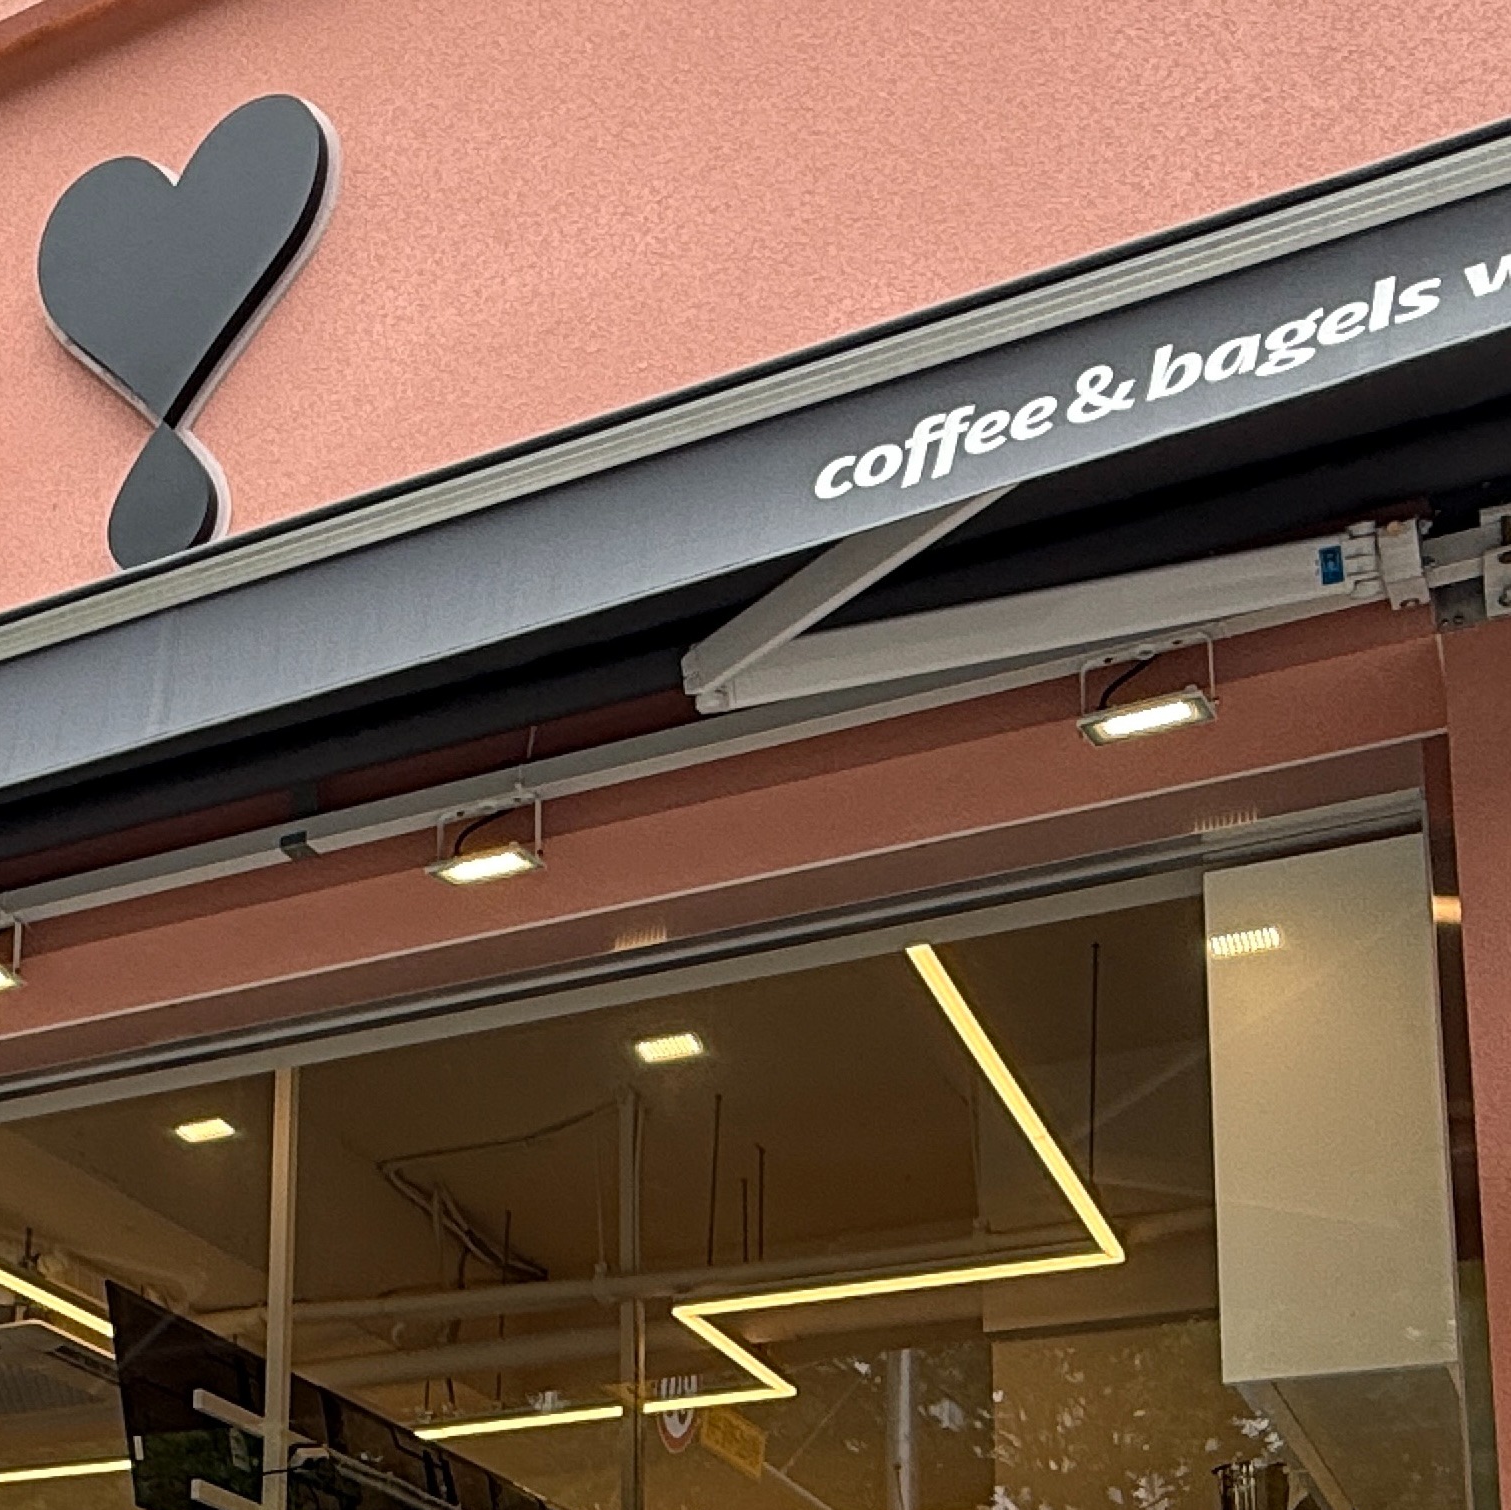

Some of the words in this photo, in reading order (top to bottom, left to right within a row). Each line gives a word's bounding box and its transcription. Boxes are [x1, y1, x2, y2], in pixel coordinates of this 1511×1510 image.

[814, 395, 1057, 500] coffee
[1066, 366, 1136, 426] &
[1145, 277, 1441, 401] bagels
